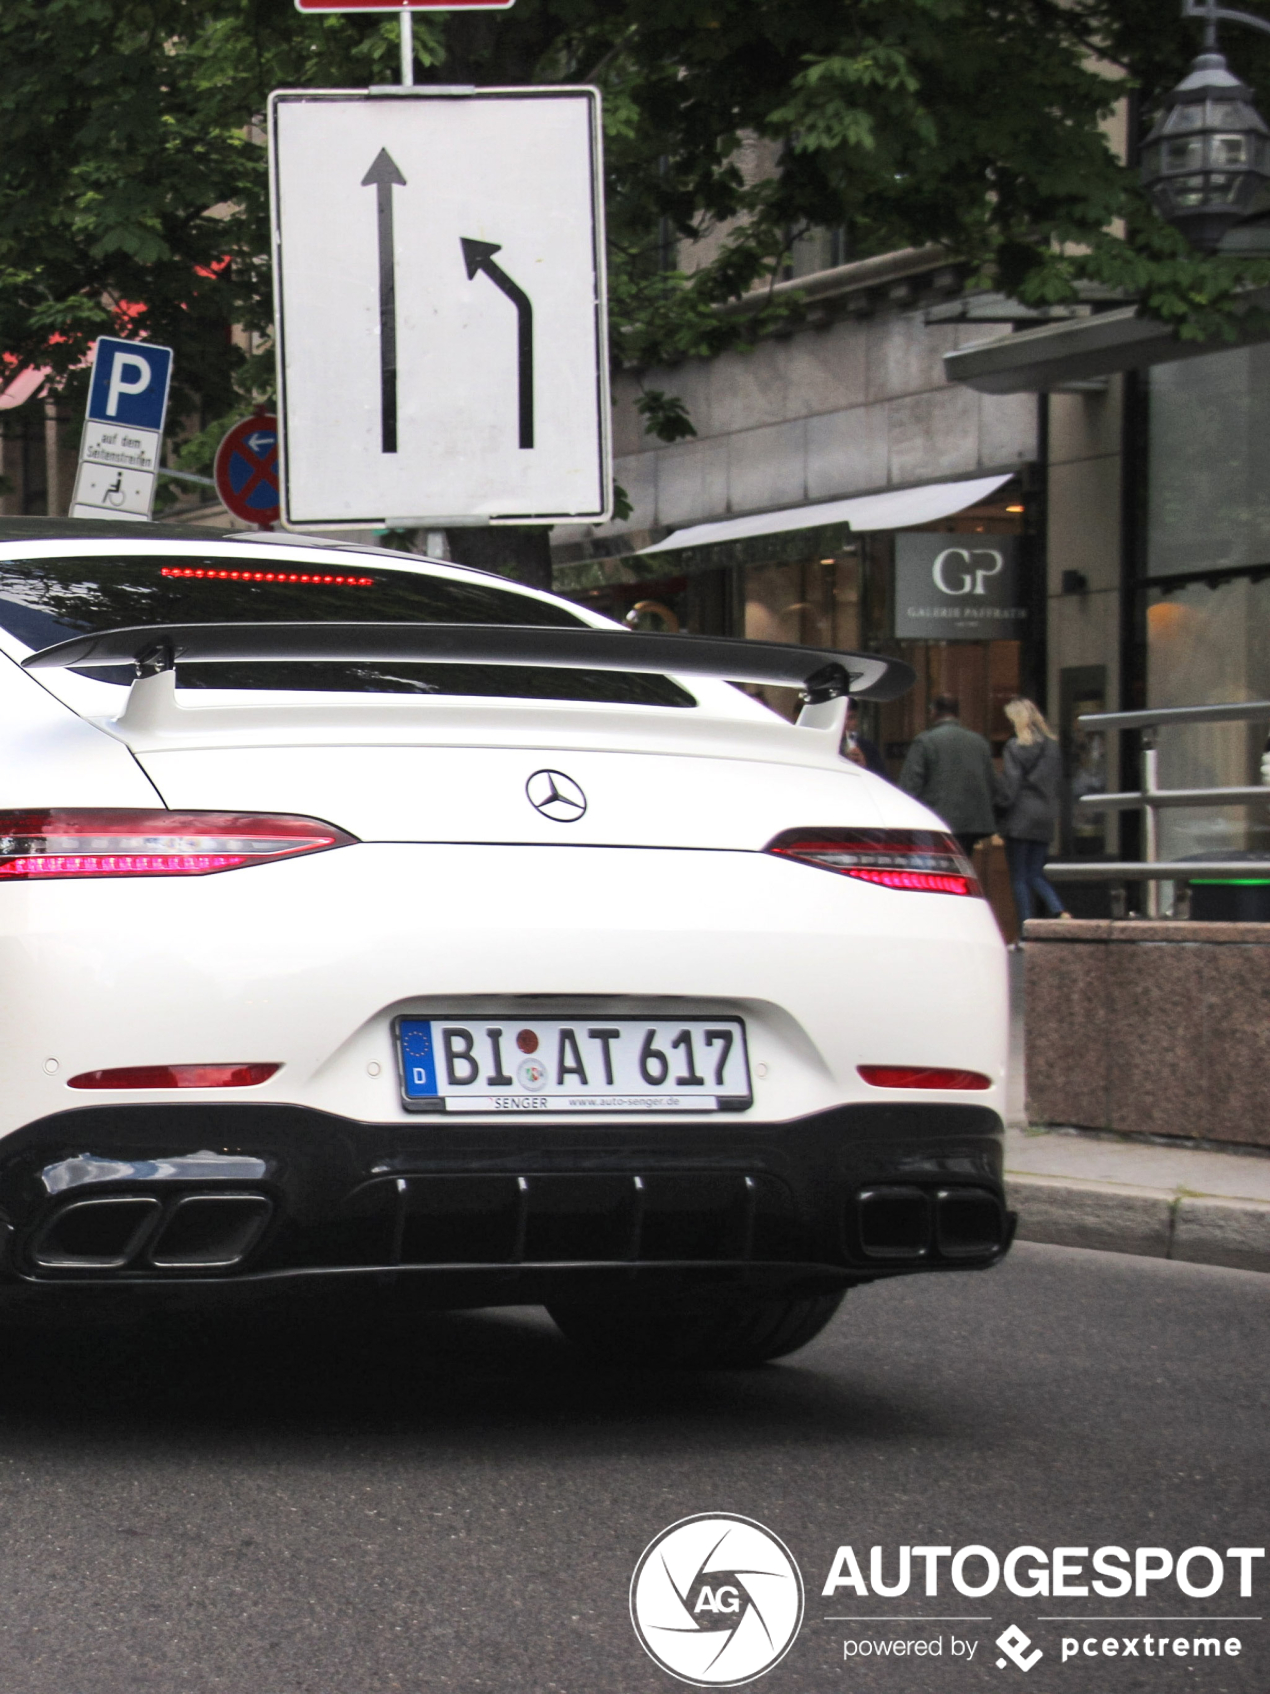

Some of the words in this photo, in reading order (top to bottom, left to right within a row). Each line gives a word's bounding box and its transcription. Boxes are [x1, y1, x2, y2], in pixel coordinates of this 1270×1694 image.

[106, 352, 152, 417] P
[101, 433, 118, 446] auf
[121, 434, 142, 449] dem
[86, 445, 153, 467] Seitenstreifen
[932, 547, 1004, 595] GP
[442, 1026, 514, 1087] BI
[556, 1027, 621, 1086] AT
[639, 1028, 735, 1087] 617
[413, 1067, 427, 1084] D
[494, 1096, 548, 1109] SENGER
[568, 1095, 681, 1108] www.auto-senger.de
